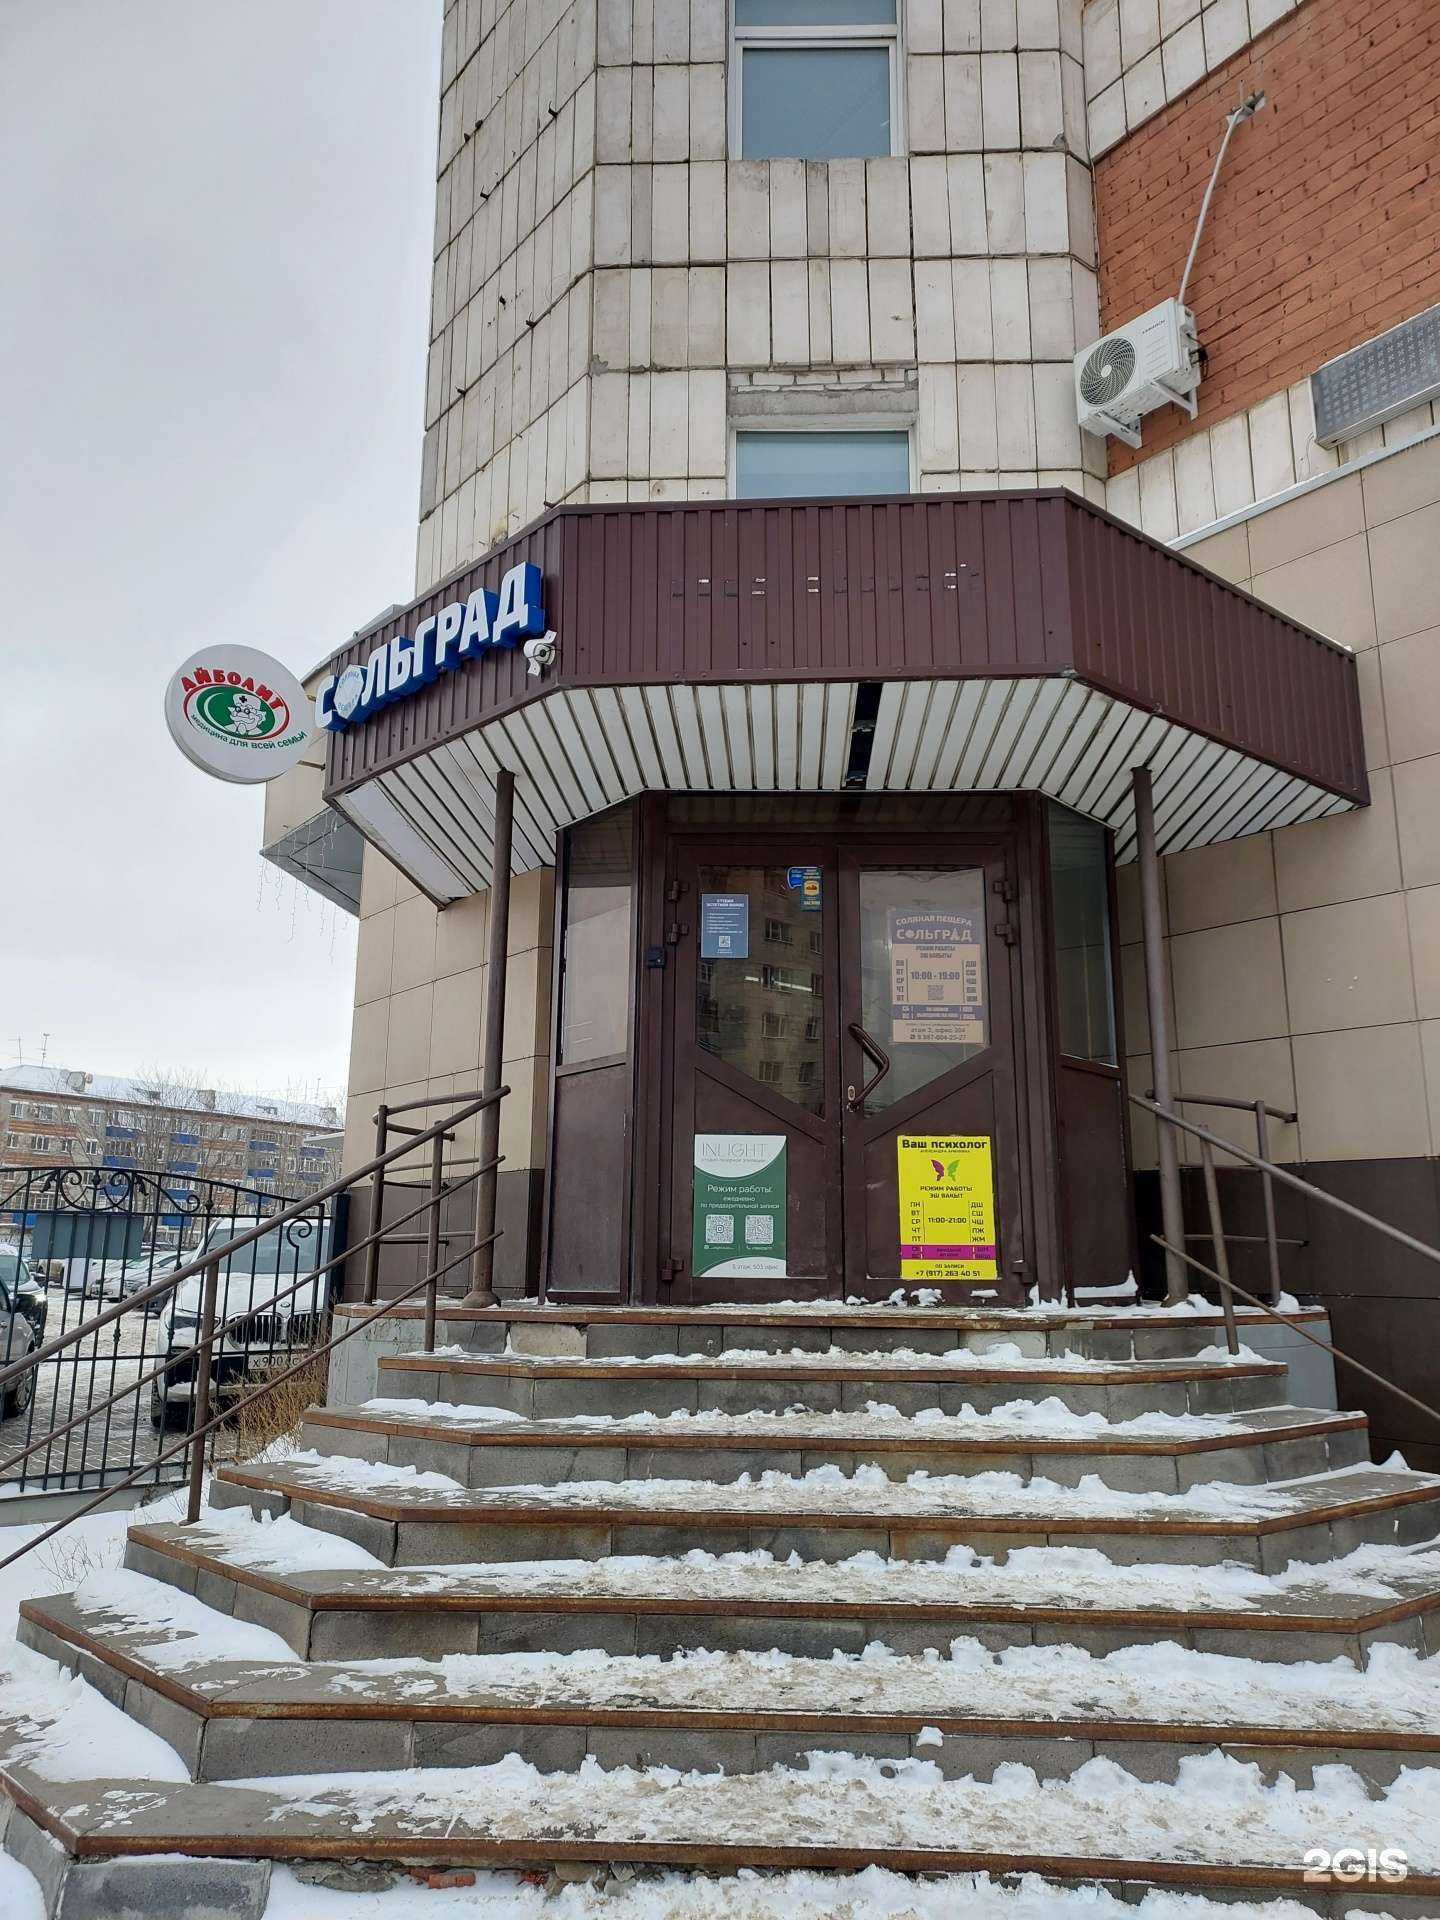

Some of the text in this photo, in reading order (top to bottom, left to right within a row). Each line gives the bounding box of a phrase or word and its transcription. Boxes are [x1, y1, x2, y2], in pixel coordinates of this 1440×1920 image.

[181, 667, 284, 710] АЙБОЛИТ
[190, 714, 308, 750] медицина для всей семьи
[895, 914, 972, 927] СОЛЯНАЯ ПЕЩЕРА
[896, 928, 973, 943] СОЛЬГРАД
[902, 1139, 987, 1149] Ваш психолог
[707, 1184, 737, 1192] Режим
